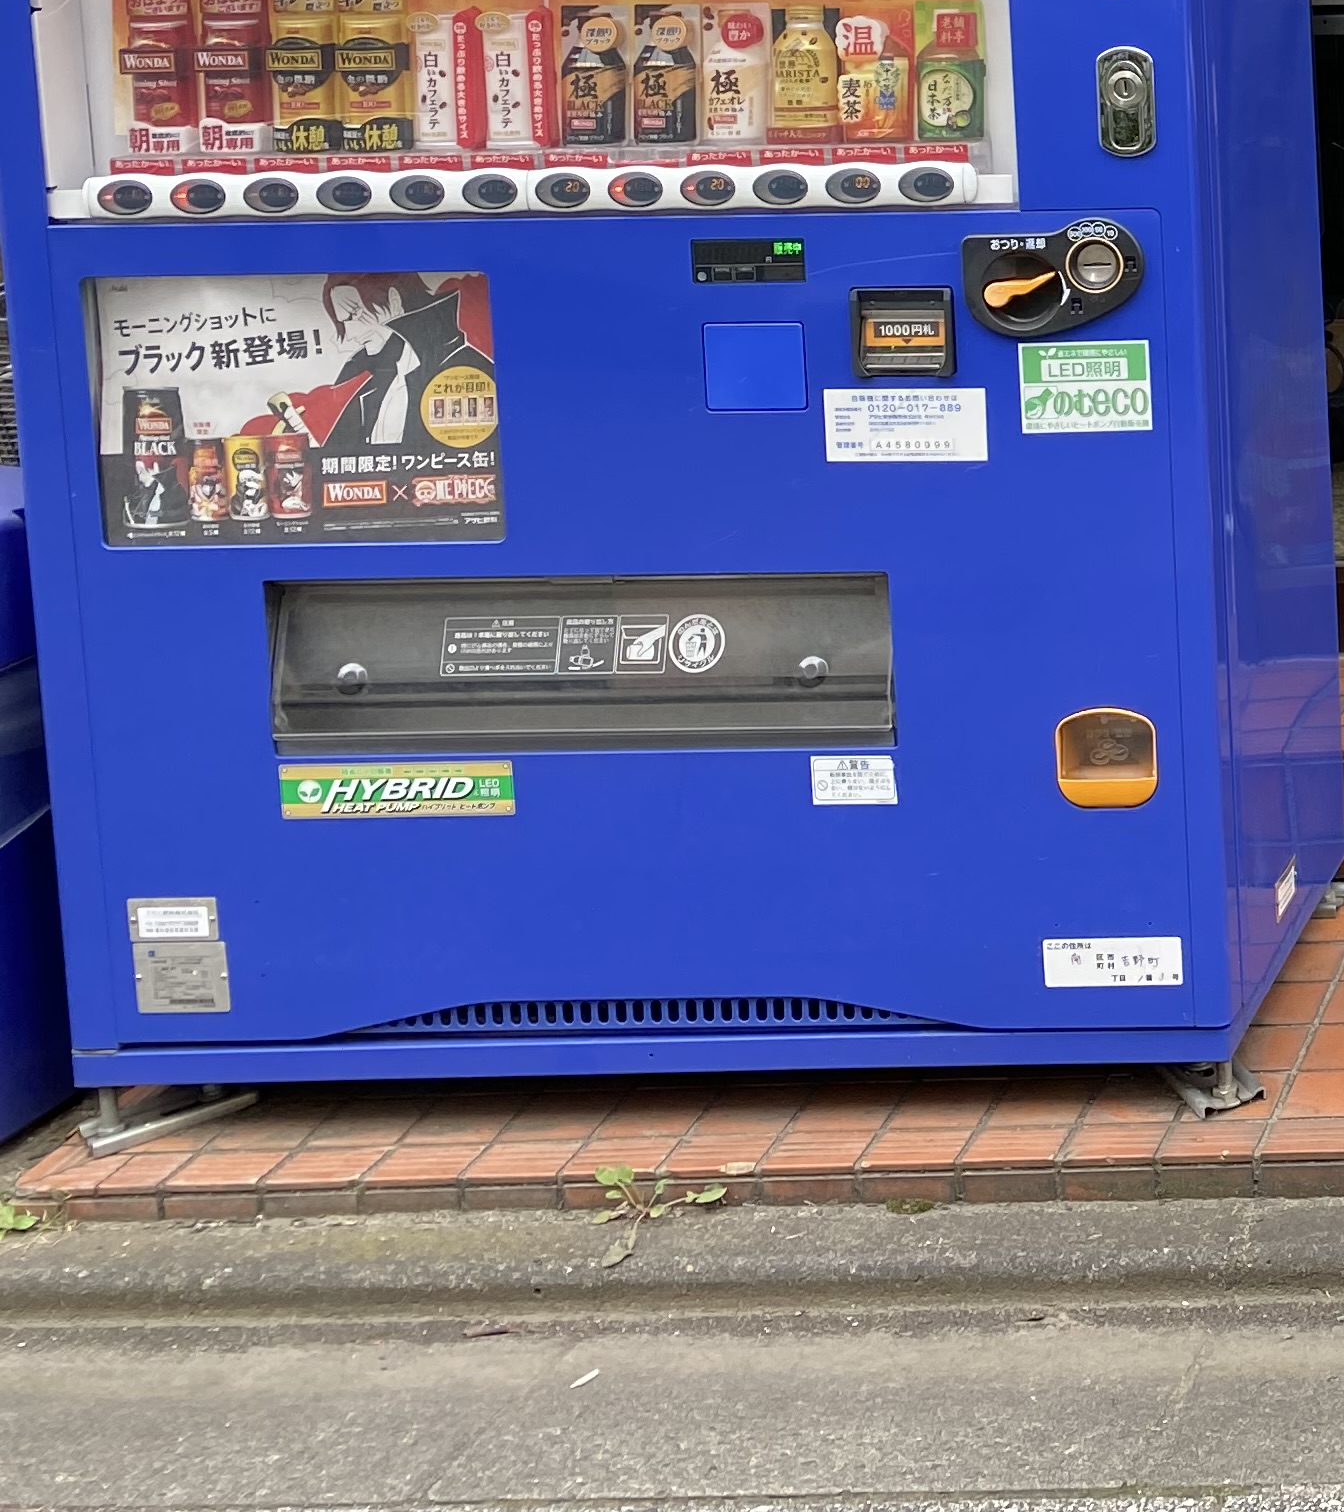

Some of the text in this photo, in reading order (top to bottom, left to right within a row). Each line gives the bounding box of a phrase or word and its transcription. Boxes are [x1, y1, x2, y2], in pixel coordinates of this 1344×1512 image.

[728, 30, 751, 42] 豊か
[842, 21, 879, 57] 温
[124, 53, 170, 68] WONDA
[197, 51, 244, 67] WONDA
[269, 51, 316, 65] WONDA
[340, 51, 390, 65] WONDA
[775, 69, 820, 78] BARISTA
[423, 50, 440, 130] 白いカフェラテ
[495, 50, 513, 129] 白いカフェラテ
[568, 73, 599, 100] 極
[639, 72, 669, 99] 極
[710, 69, 741, 96] 極
[567, 98, 604, 112] BLACK
[637, 98, 674, 110] BLACK
[708, 97, 746, 106] カフェオレ
[841, 78, 862, 121] 麦茶
[926, 79, 941, 121] 日本茶
[129, 127, 151, 153] 朝
[152, 140, 181, 151] 専用
[202, 125, 224, 150] 朝
[225, 137, 254, 149] 専用
[773, 242, 803, 255] 販売中
[113, 306, 278, 338] モーニングショットに
[878, 322, 935, 338] 1000円札
[117, 329, 324, 377] ブラック新登場!
[1047, 360, 1122, 378] LED照明
[867, 403, 962, 413] 0120-017-889
[1053, 387, 1149, 417] のむeco
[138, 419, 171, 433] WONDA
[134, 440, 177, 457] BLACK
[321, 451, 496, 475] 期間限定! ワンピース缶!
[327, 482, 382, 502] WONDA
[677, 652, 716, 670] リサイクル
[849, 759, 870, 770] 警告
[479, 778, 500, 788] LED
[321, 777, 474, 814] HYBRID
[333, 801, 421, 813] HEAT PUMP
[1046, 942, 1092, 950] ここの住所は
